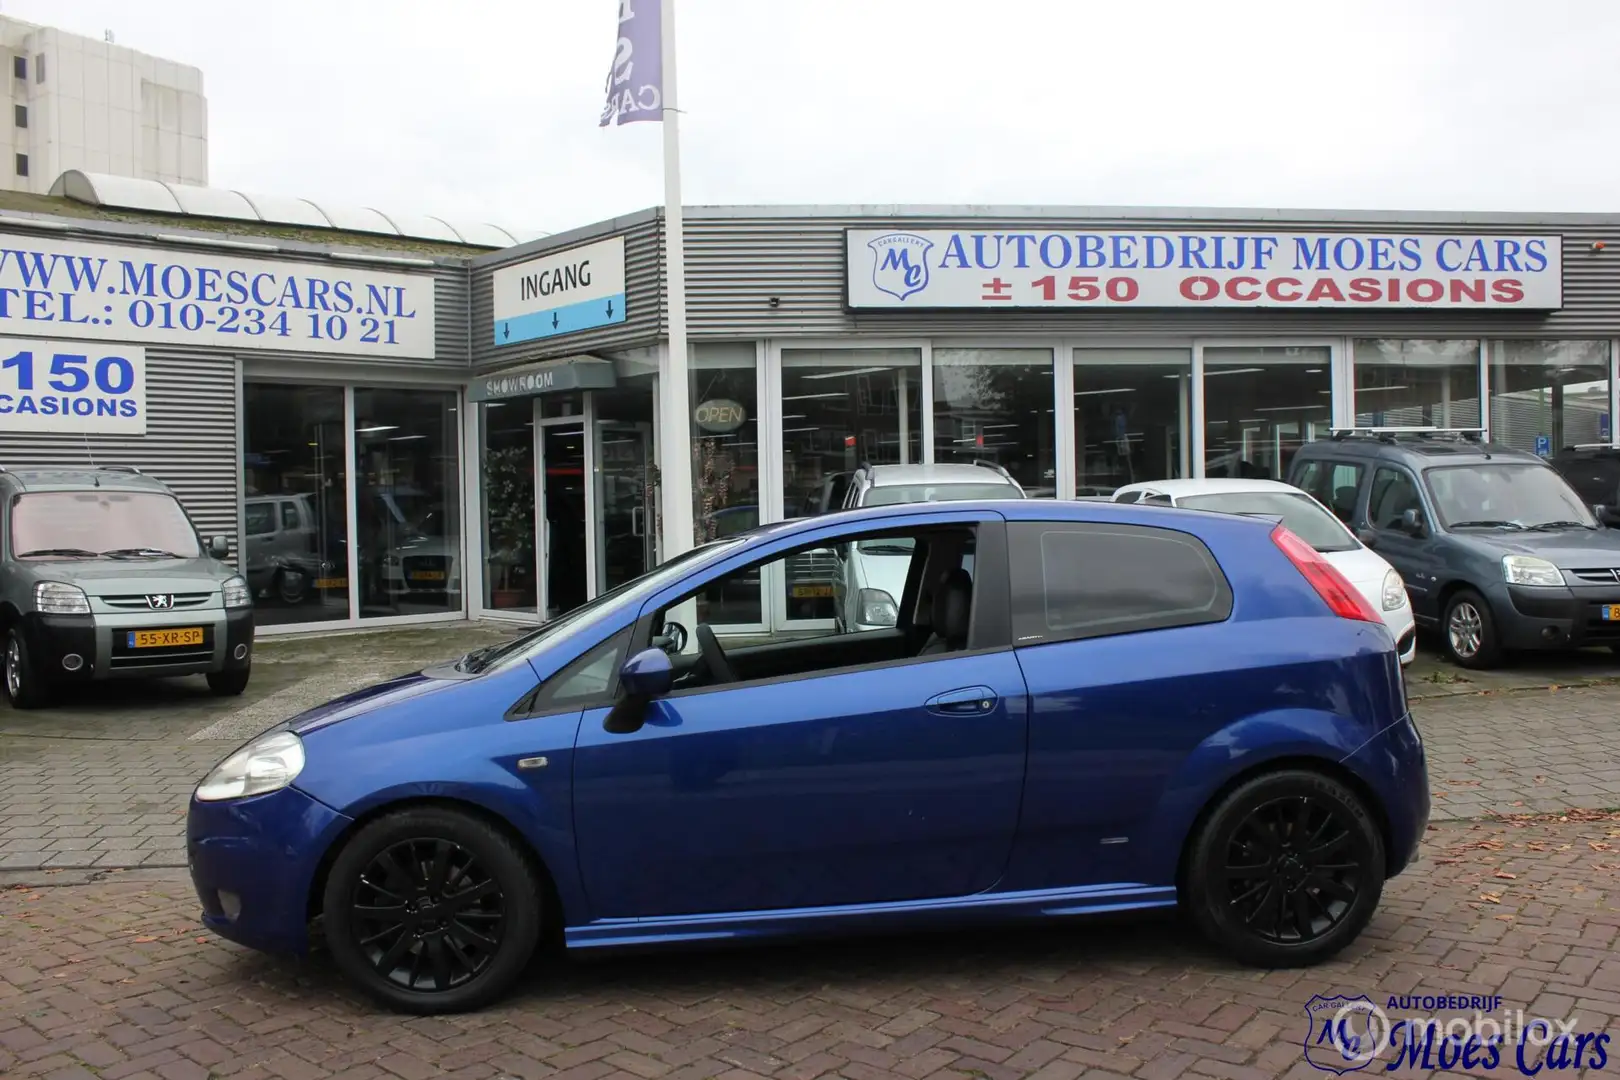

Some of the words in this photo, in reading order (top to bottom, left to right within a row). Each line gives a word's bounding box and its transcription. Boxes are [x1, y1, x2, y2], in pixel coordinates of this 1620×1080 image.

[938, 233, 1279, 271] AUTOBEDRIJF
[1292, 236, 1423, 272] MOES
[1435, 238, 1549, 273] CARS
[521, 260, 591, 301] INGANG
[1031, 275, 1139, 302] 150
[1179, 275, 1525, 303] OCCASIONS
[128, 299, 291, 337] 010-234
[308, 313, 347, 341] 10
[360, 319, 399, 344] 21
[2, 351, 135, 394] 150
[486, 371, 553, 396] SHOWROOM
[695, 406, 742, 423] OPEN
[140, 630, 200, 645] 55-XR-SP
